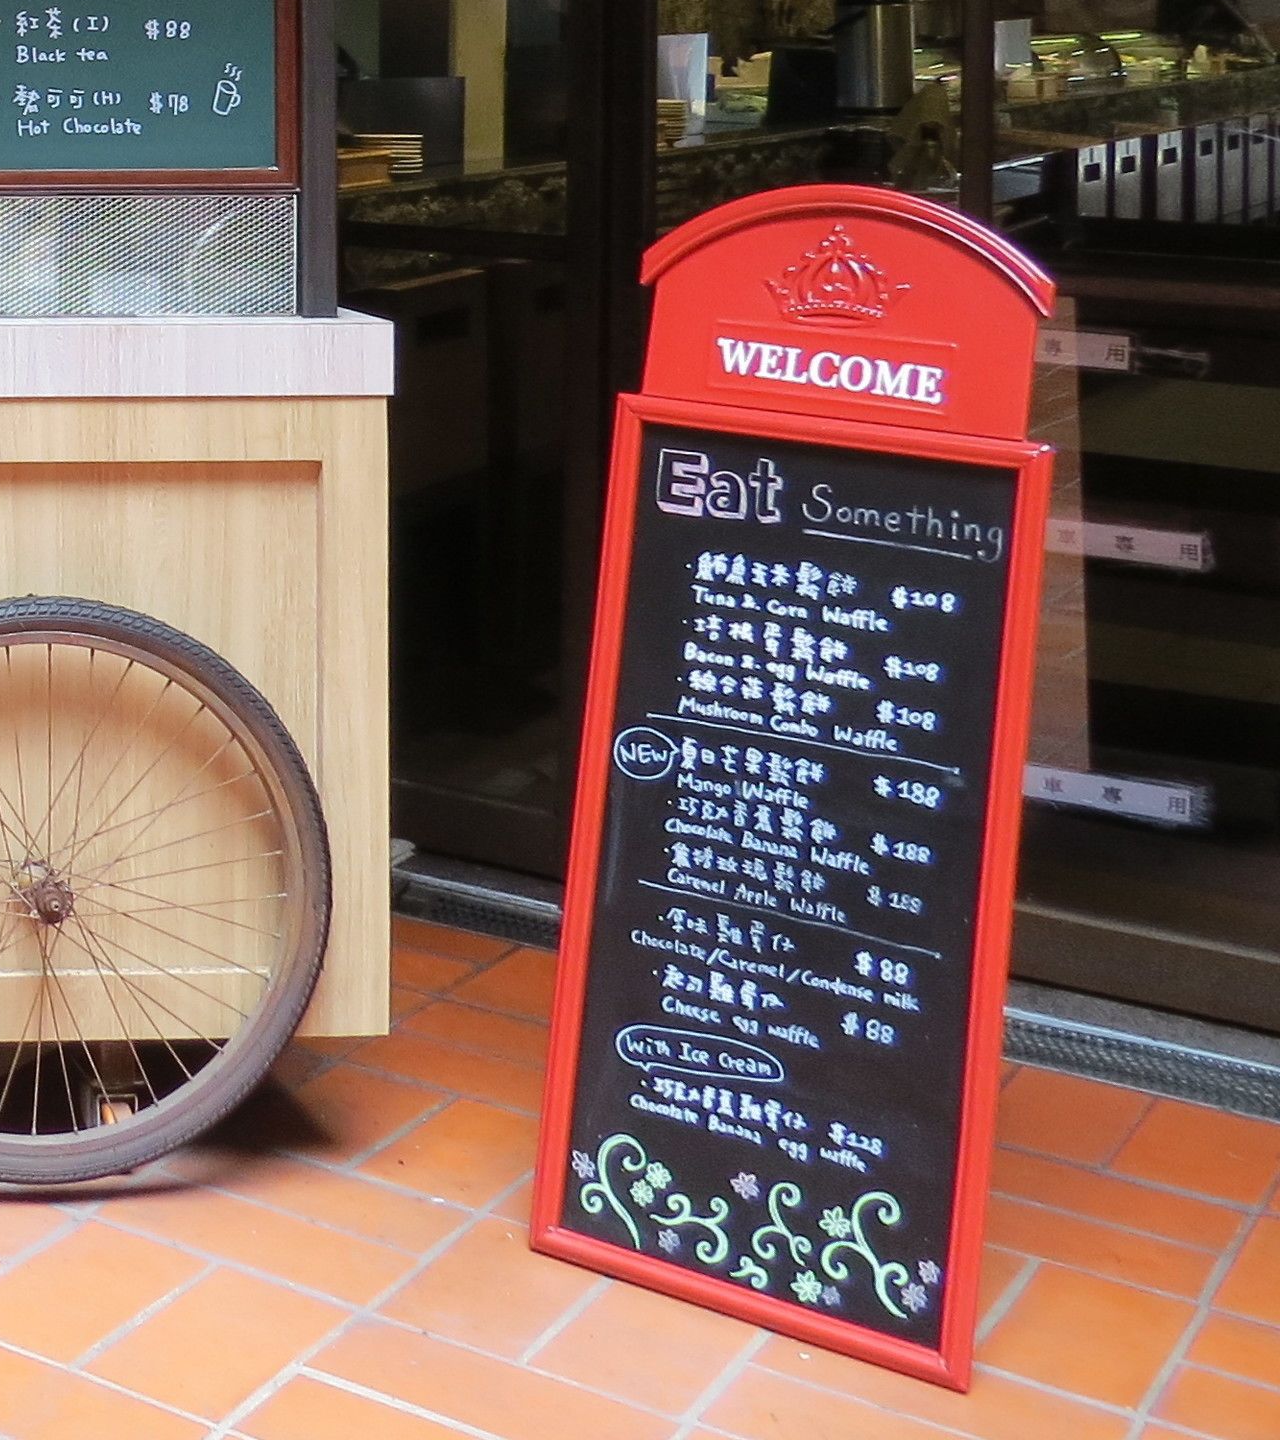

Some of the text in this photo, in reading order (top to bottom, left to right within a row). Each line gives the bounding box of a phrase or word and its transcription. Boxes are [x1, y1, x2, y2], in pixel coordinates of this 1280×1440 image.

[144, 19, 191, 40] $88
[16, 46, 109, 63] Black tea
[149, 92, 189, 115] $78
[17, 118, 142, 136] Hot Chocolate
[716, 337, 944, 405] WELCOME
[656, 448, 1004, 563] Eat Something
[691, 584, 736, 608] Tuna
[766, 600, 809, 618] Corn
[822, 605, 889, 632] Waffle
[890, 585, 957, 613] $108
[683, 642, 736, 666] Bacon
[766, 661, 797, 681] egg
[805, 663, 871, 690] Waffle
[883, 655, 941, 682] $108
[677, 695, 898, 751] Mushroom Combo Waffle
[876, 699, 937, 731] $108
[619, 744, 669, 764] NEW
[676, 773, 810, 810] Mango Waffle
[664, 817, 871, 875] Chocolate Banana Waffle
[790, 897, 848, 925] Waffle
[854, 950, 910, 985] $88
[882, 992, 922, 1012] milk
[661, 995, 821, 1050] Cheese egg waffle
[840, 1011, 896, 1045] $88
[624, 1034, 772, 1076] With Ice Cream
[778, 1138, 809, 1161] egg
